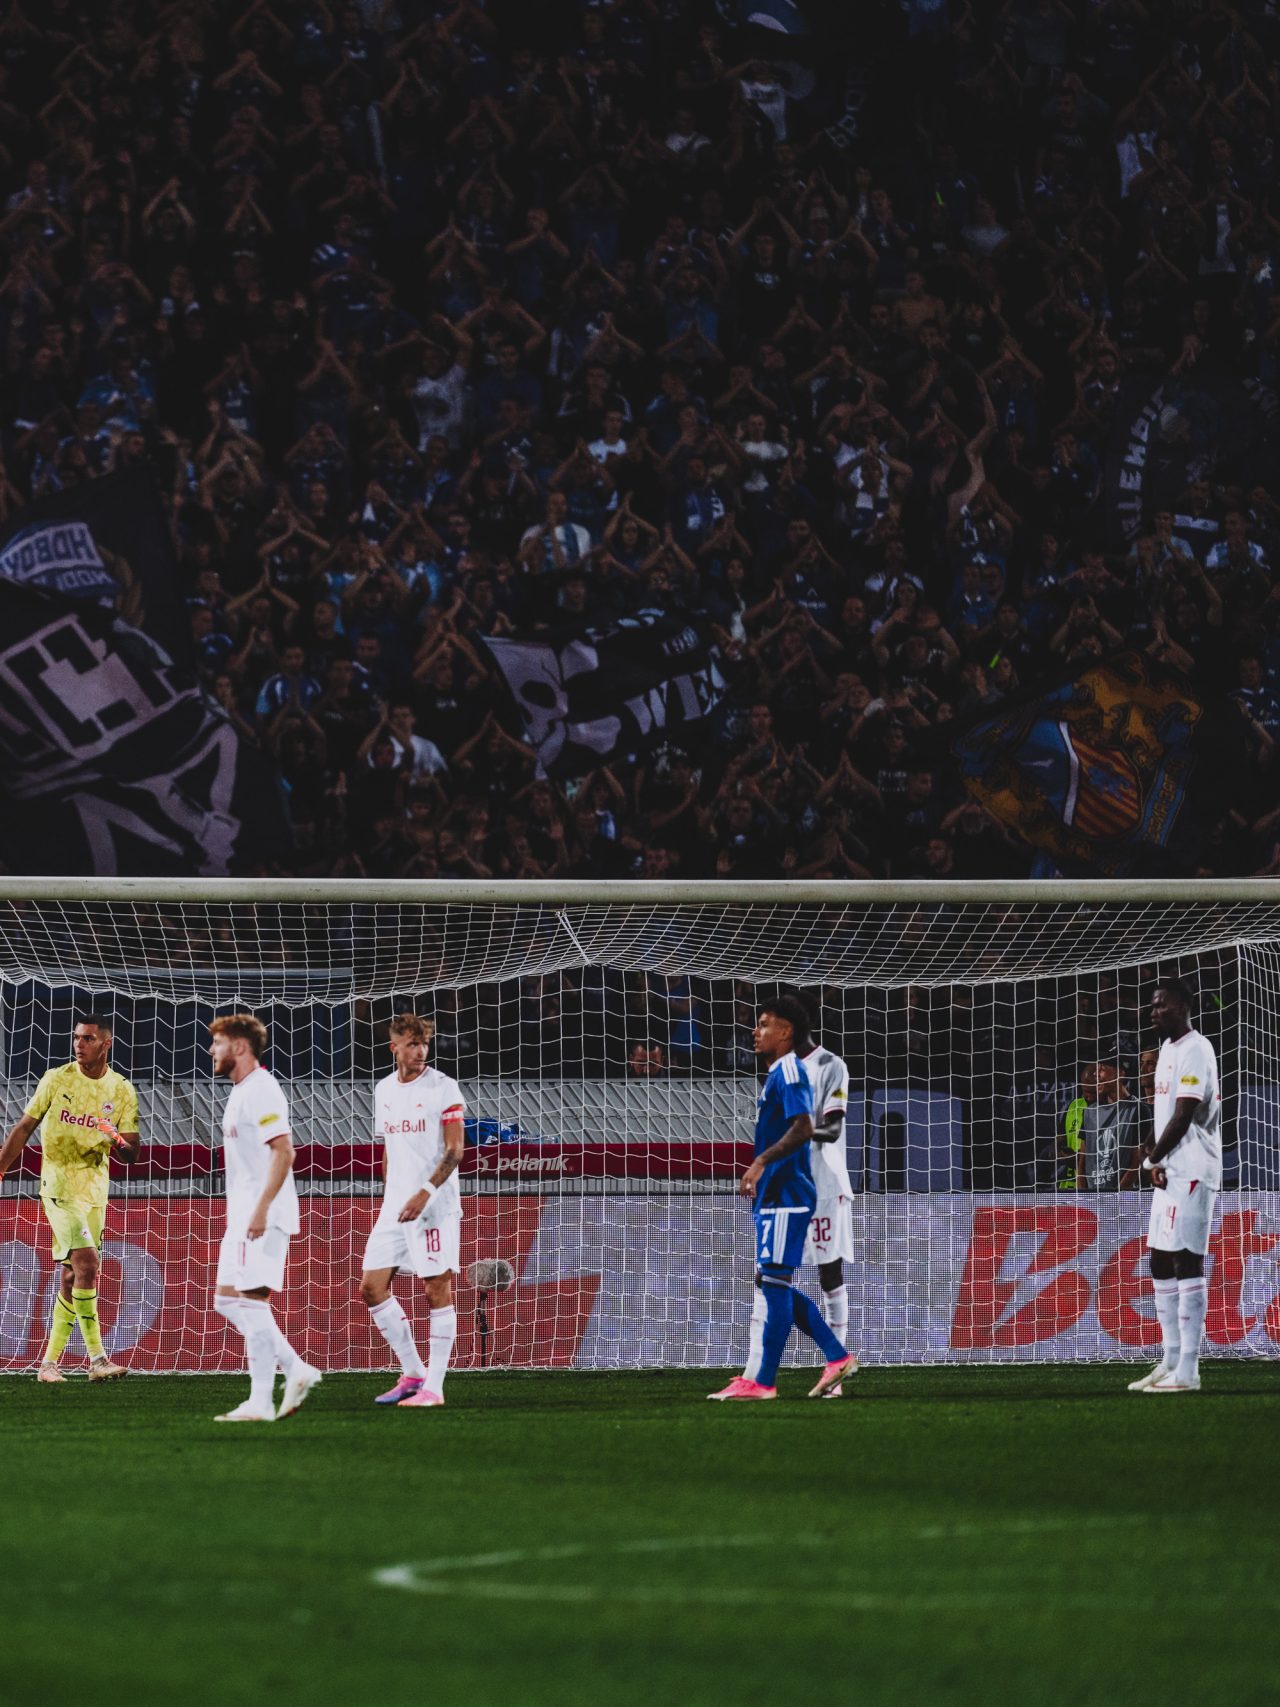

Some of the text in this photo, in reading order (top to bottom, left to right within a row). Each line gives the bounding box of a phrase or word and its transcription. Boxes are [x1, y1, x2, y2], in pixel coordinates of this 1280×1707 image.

[495, 1153, 571, 1175] polanik
[424, 1228, 441, 1253] 18
[810, 1217, 832, 1243] 32
